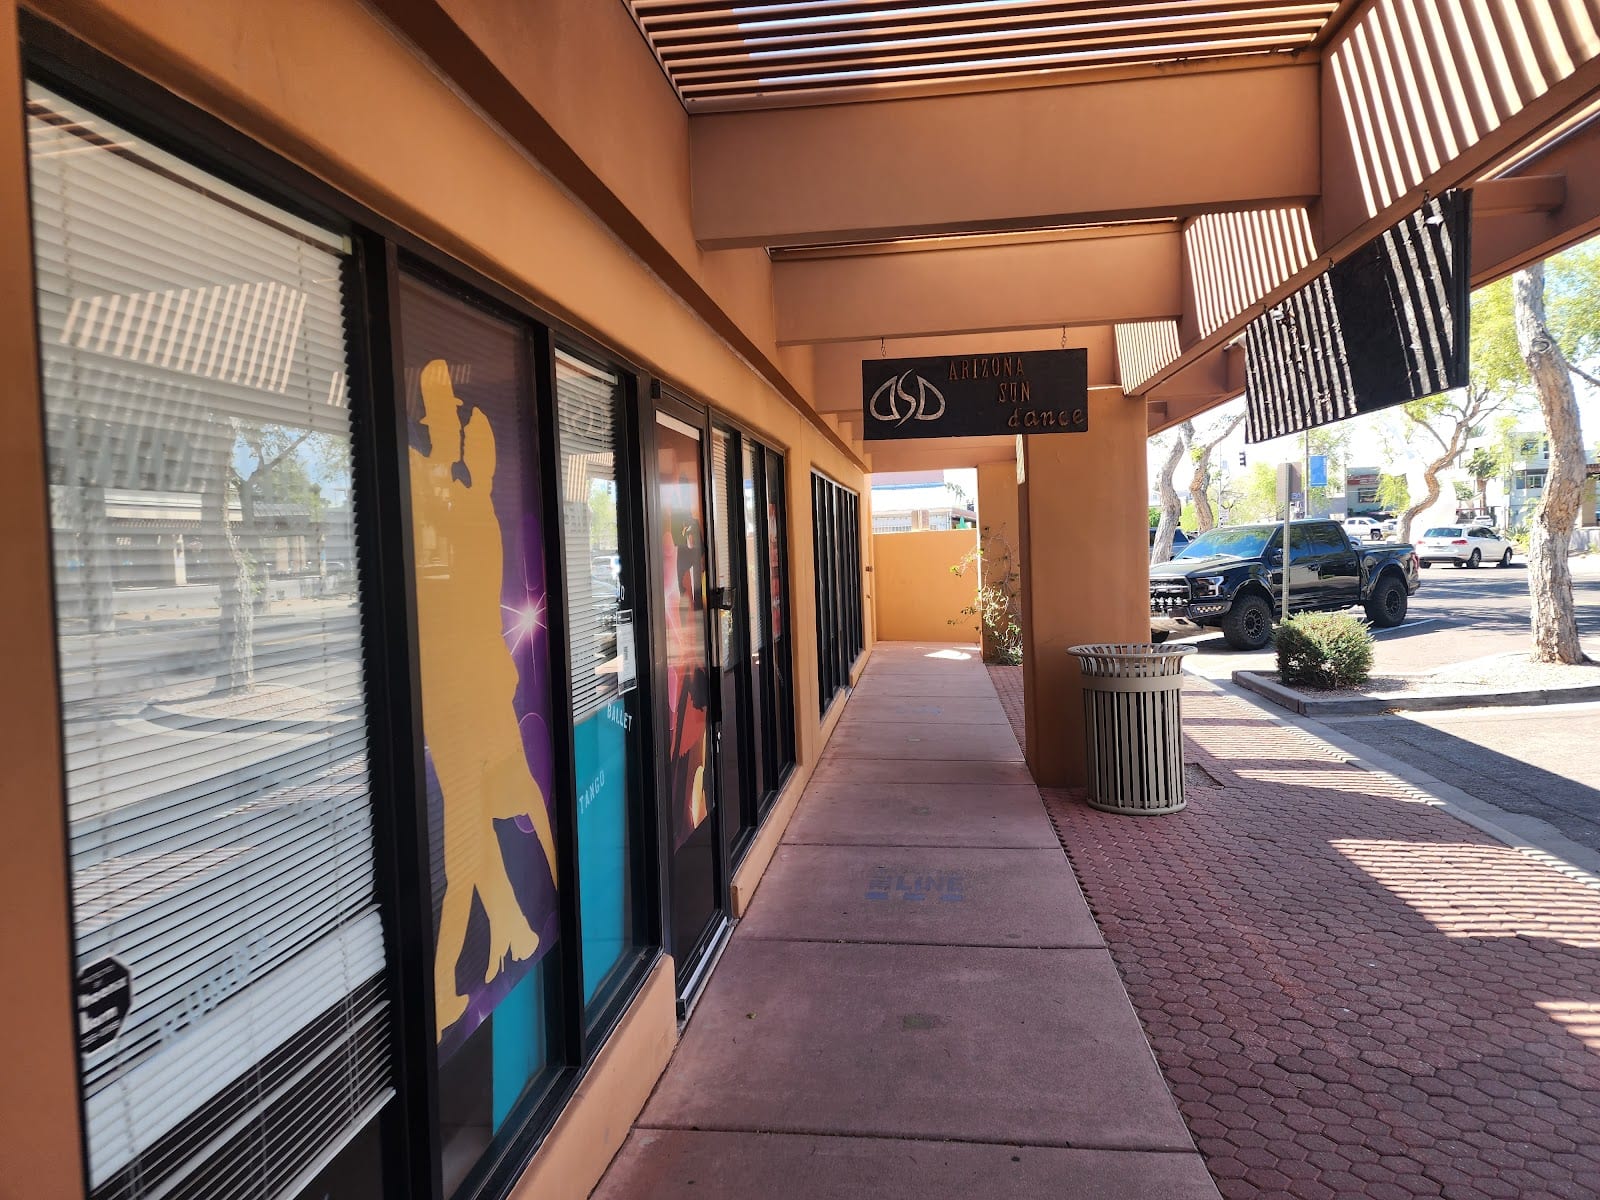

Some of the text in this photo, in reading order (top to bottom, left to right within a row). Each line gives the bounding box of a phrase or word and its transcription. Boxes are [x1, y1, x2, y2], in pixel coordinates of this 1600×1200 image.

[949, 357, 1025, 380] ARIZONA
[999, 382, 1031, 403] SUN
[1007, 407, 1085, 427] dance
[606, 701, 633, 733] BALLET
[578, 770, 605, 815] TANGO
